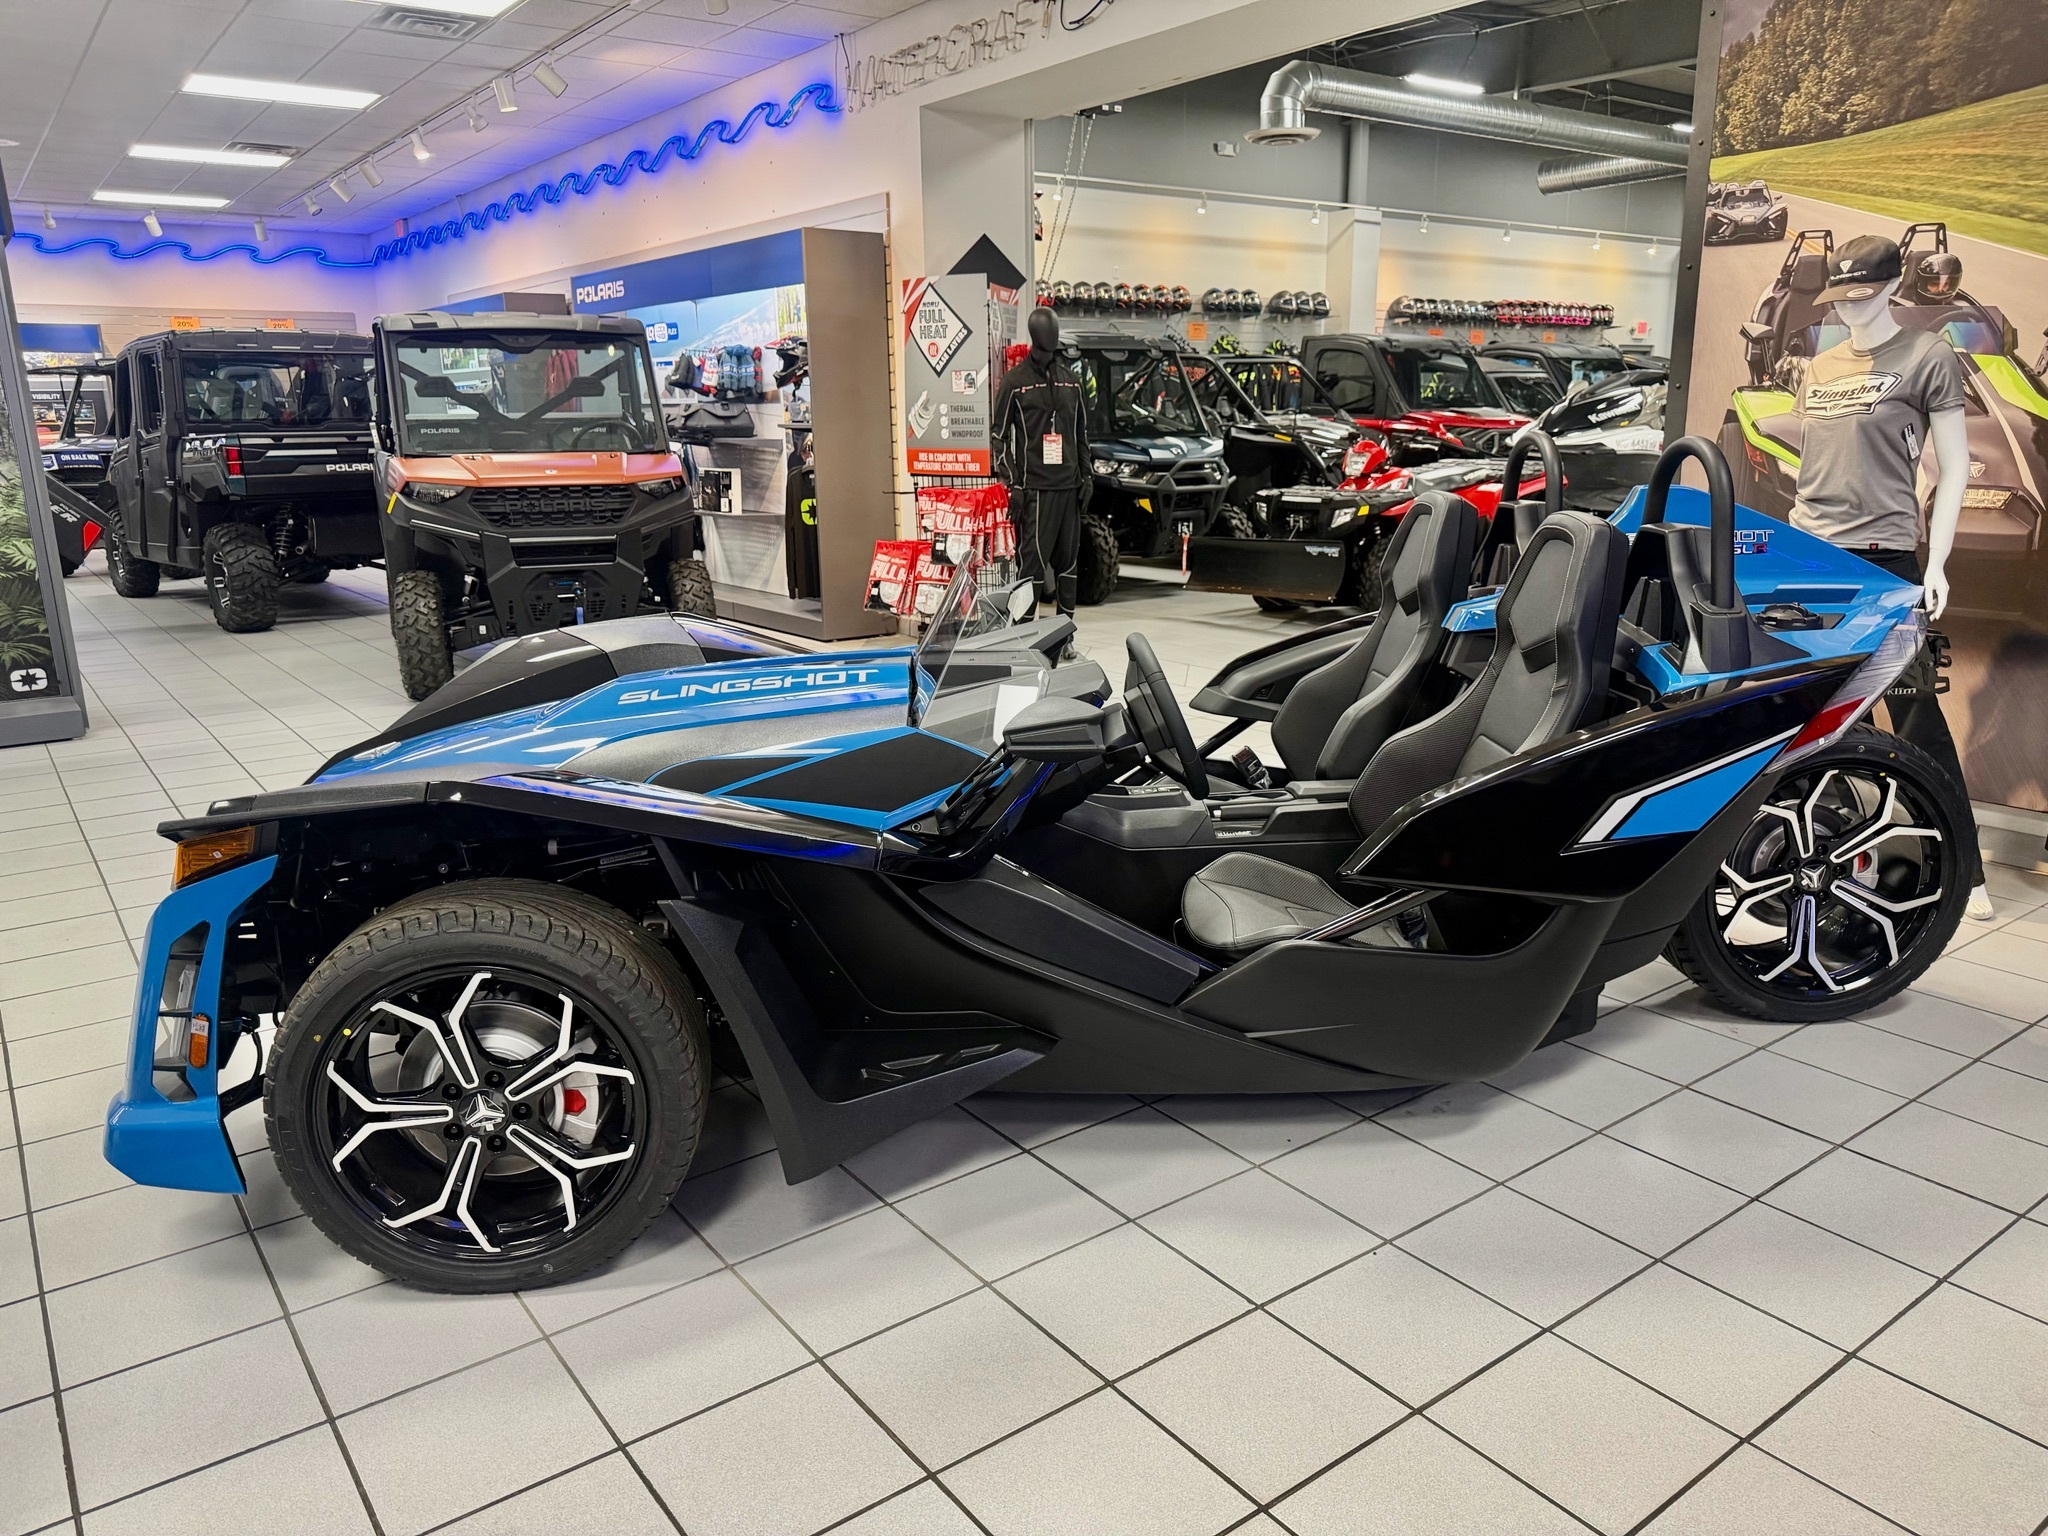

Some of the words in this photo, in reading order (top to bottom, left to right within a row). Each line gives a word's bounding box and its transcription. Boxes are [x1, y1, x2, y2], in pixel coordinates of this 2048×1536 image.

[576, 279, 625, 304] POLARIS
[918, 308, 946, 324] FULL
[919, 324, 948, 340] HEAT
[946, 327, 968, 356] LAYERS
[1808, 381, 1885, 401] Slingshot
[950, 405, 975, 413] THERMAL
[950, 417, 985, 426] BREATHABLE
[952, 429, 984, 438] WINDPROOF
[87, 453, 99, 461] NOW
[918, 452, 929, 461] RIDE
[929, 452, 934, 461] IN
[934, 453, 956, 462] COMFORT
[957, 453, 971, 462] WITH
[326, 463, 374, 472] POLARI
[913, 462, 942, 471] TEMPERATURE
[942, 462, 965, 471] CONTROL
[965, 463, 981, 472] FIBER
[505, 500, 608, 513] POLARIS
[617, 669, 880, 705] SLINGSHOT
